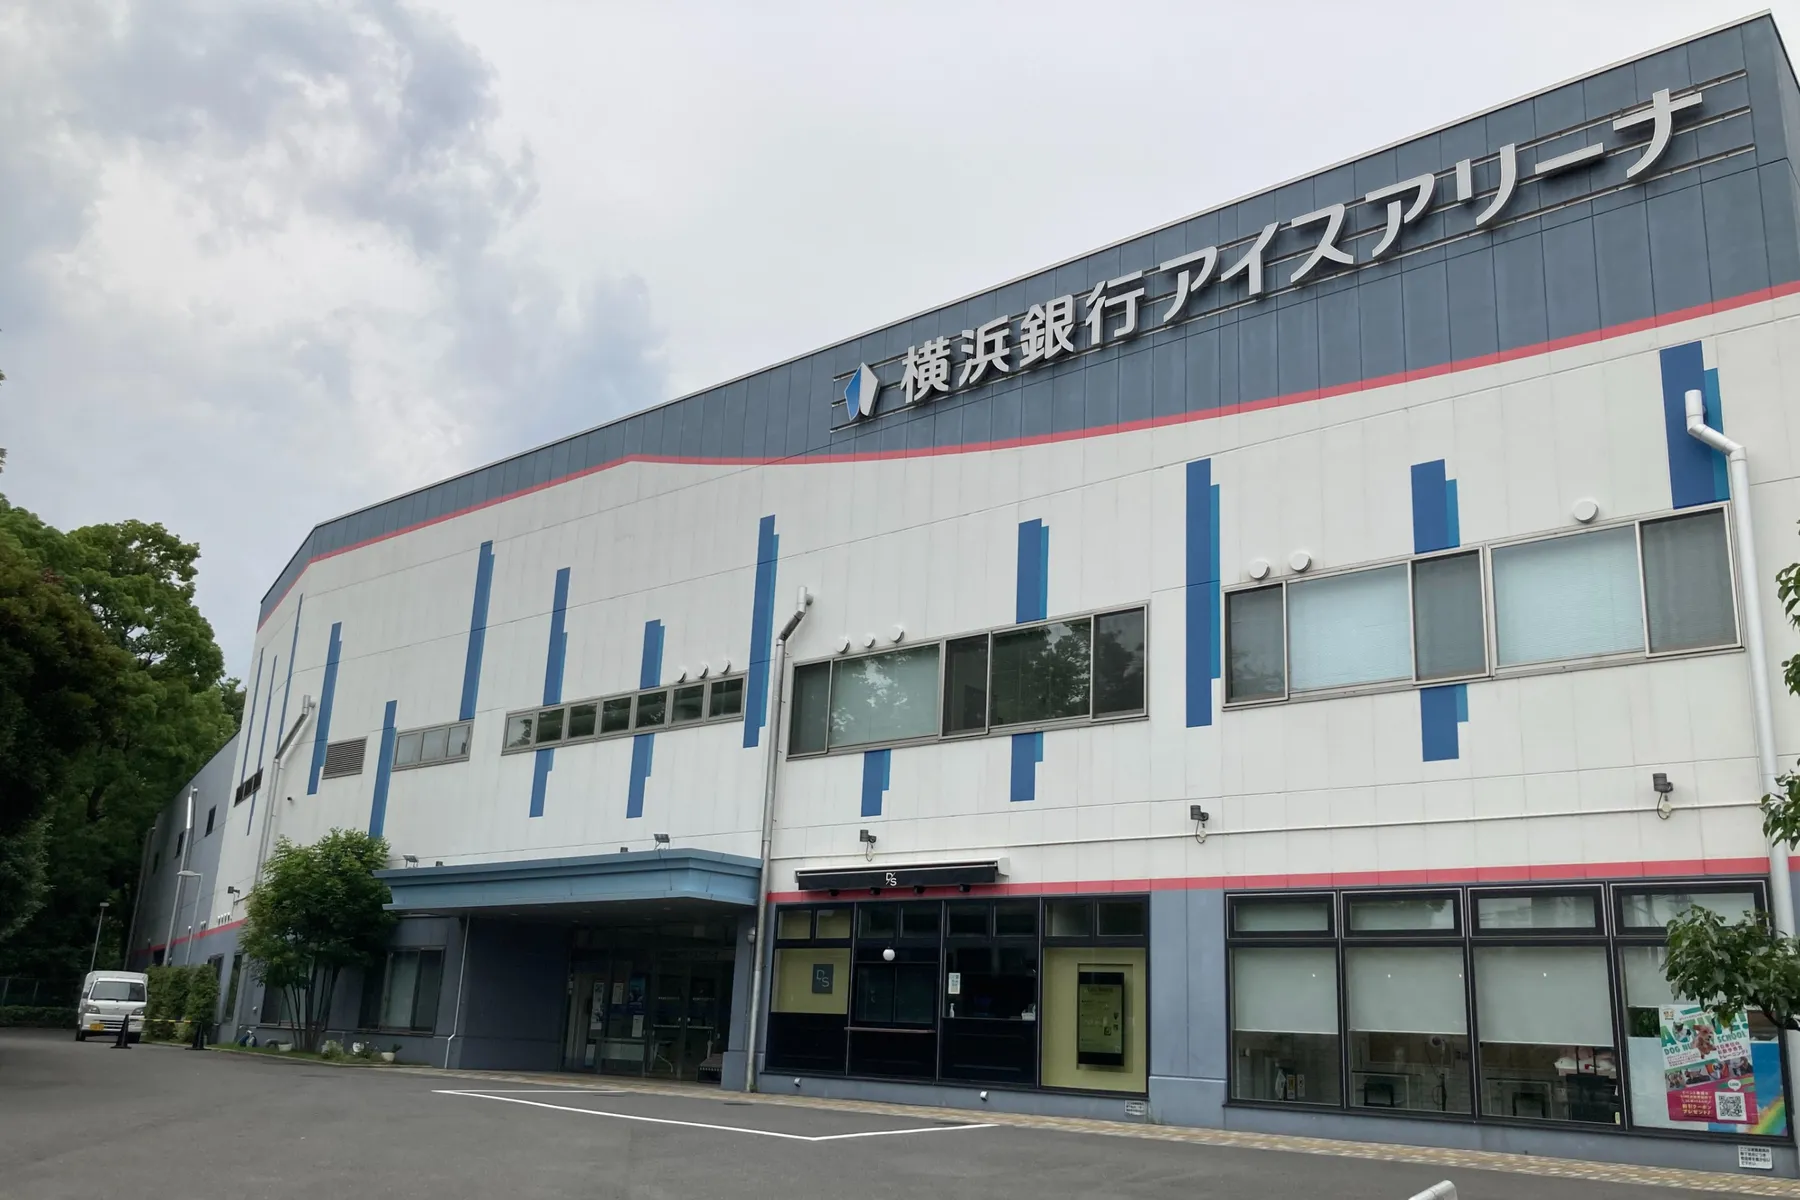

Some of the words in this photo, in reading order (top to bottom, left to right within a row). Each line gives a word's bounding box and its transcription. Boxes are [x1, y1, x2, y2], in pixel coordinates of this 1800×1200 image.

[899, 88, 1703, 405] 横浜銀行アイスアリーナ
[1717, 1031, 1747, 1043] SCHOOL
[1664, 1047, 1681, 1056] DOG
